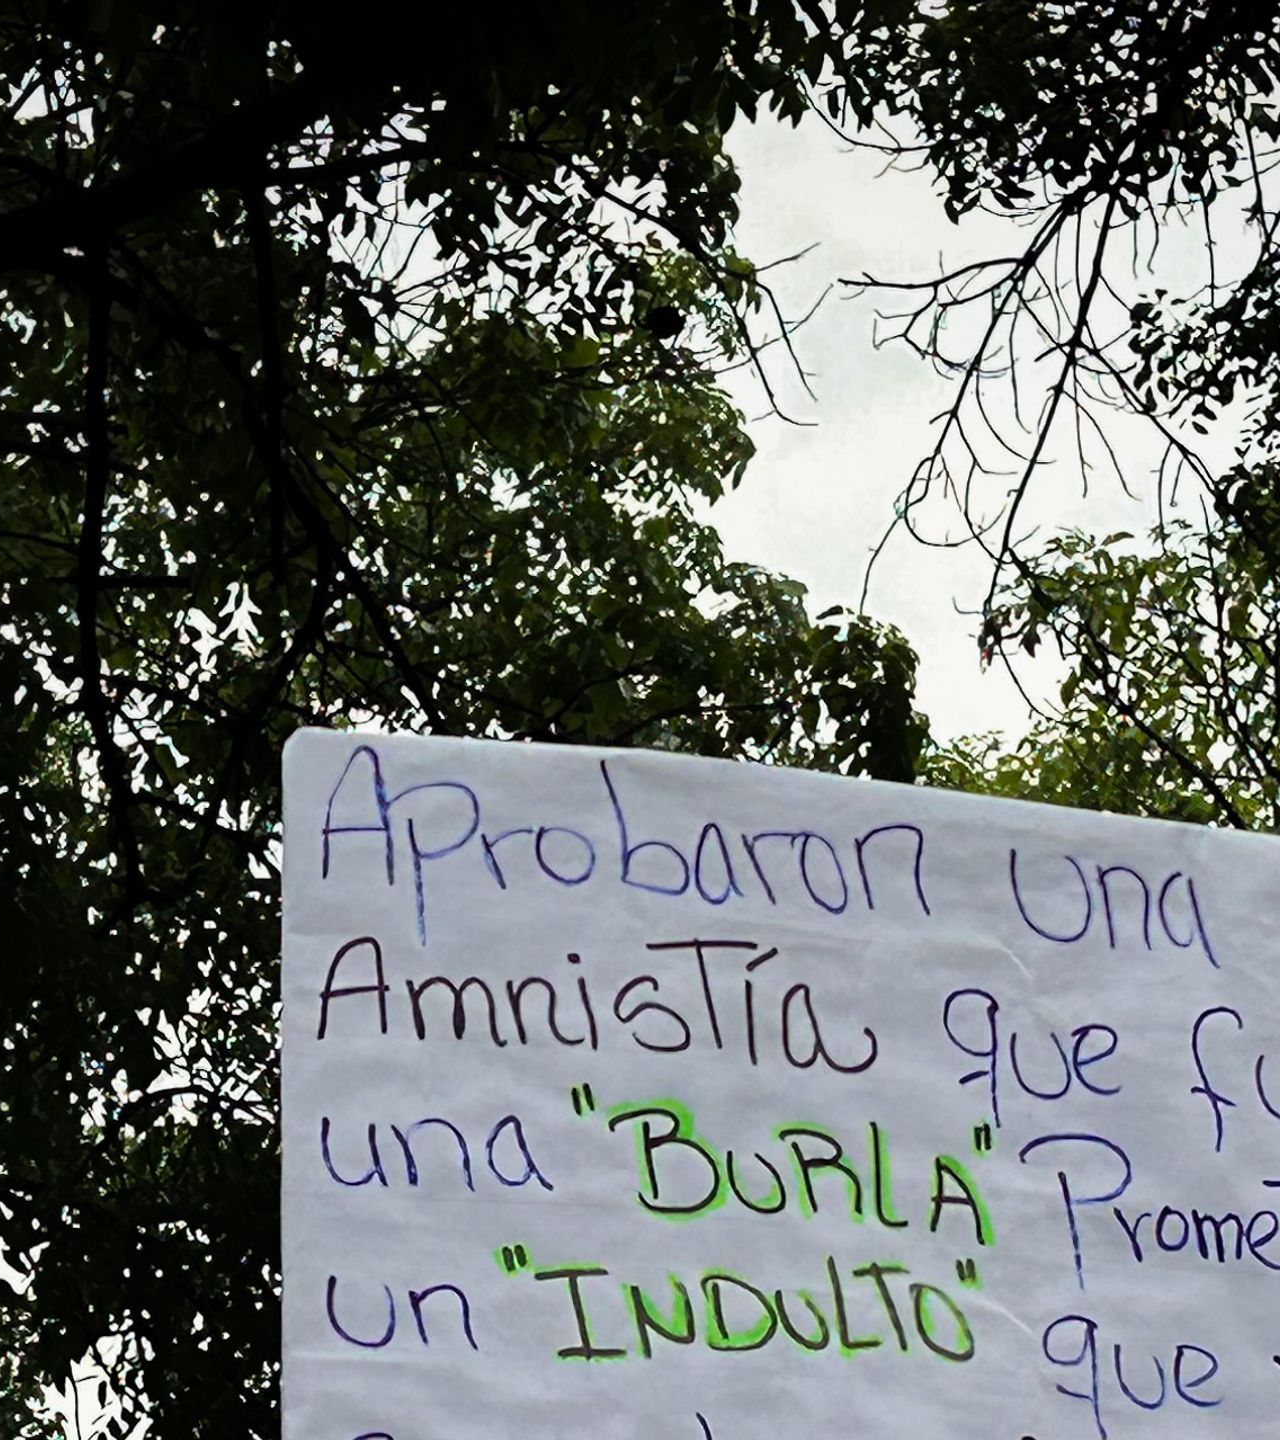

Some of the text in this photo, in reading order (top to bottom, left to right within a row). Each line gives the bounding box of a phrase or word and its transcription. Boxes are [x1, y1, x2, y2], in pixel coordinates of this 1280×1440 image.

[322, 744, 930, 946] Aprobaron
[942, 987, 1122, 1128] que
[320, 1114, 554, 1192] una
[326, 1275, 479, 1350] un
